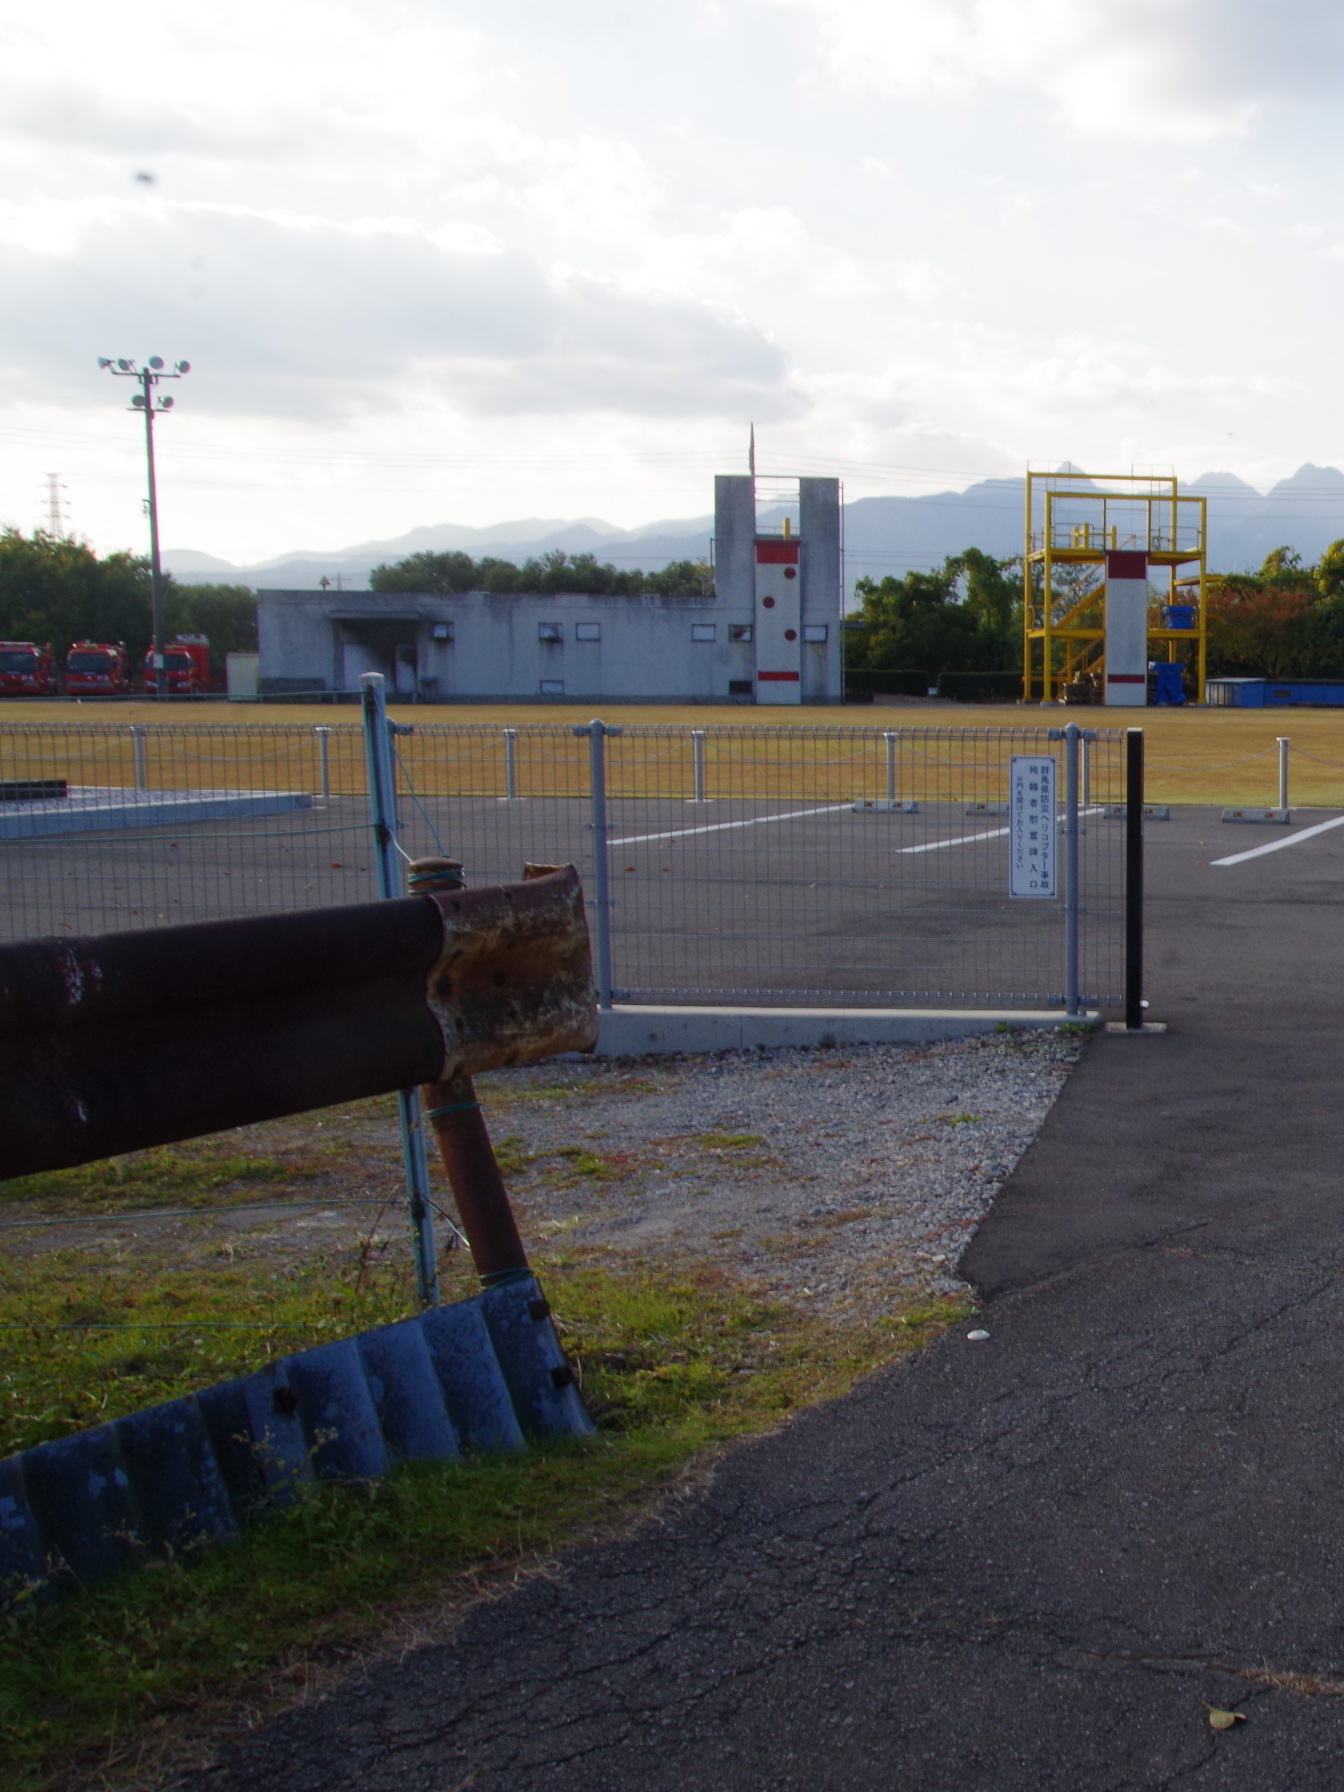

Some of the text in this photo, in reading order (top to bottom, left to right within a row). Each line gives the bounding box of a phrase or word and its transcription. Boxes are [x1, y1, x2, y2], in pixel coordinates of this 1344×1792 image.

[1029, 765, 1039, 888] 殉職者慰霊碑入口
[1040, 765, 1050, 889] 群馬県防災ヘリコプター事故
